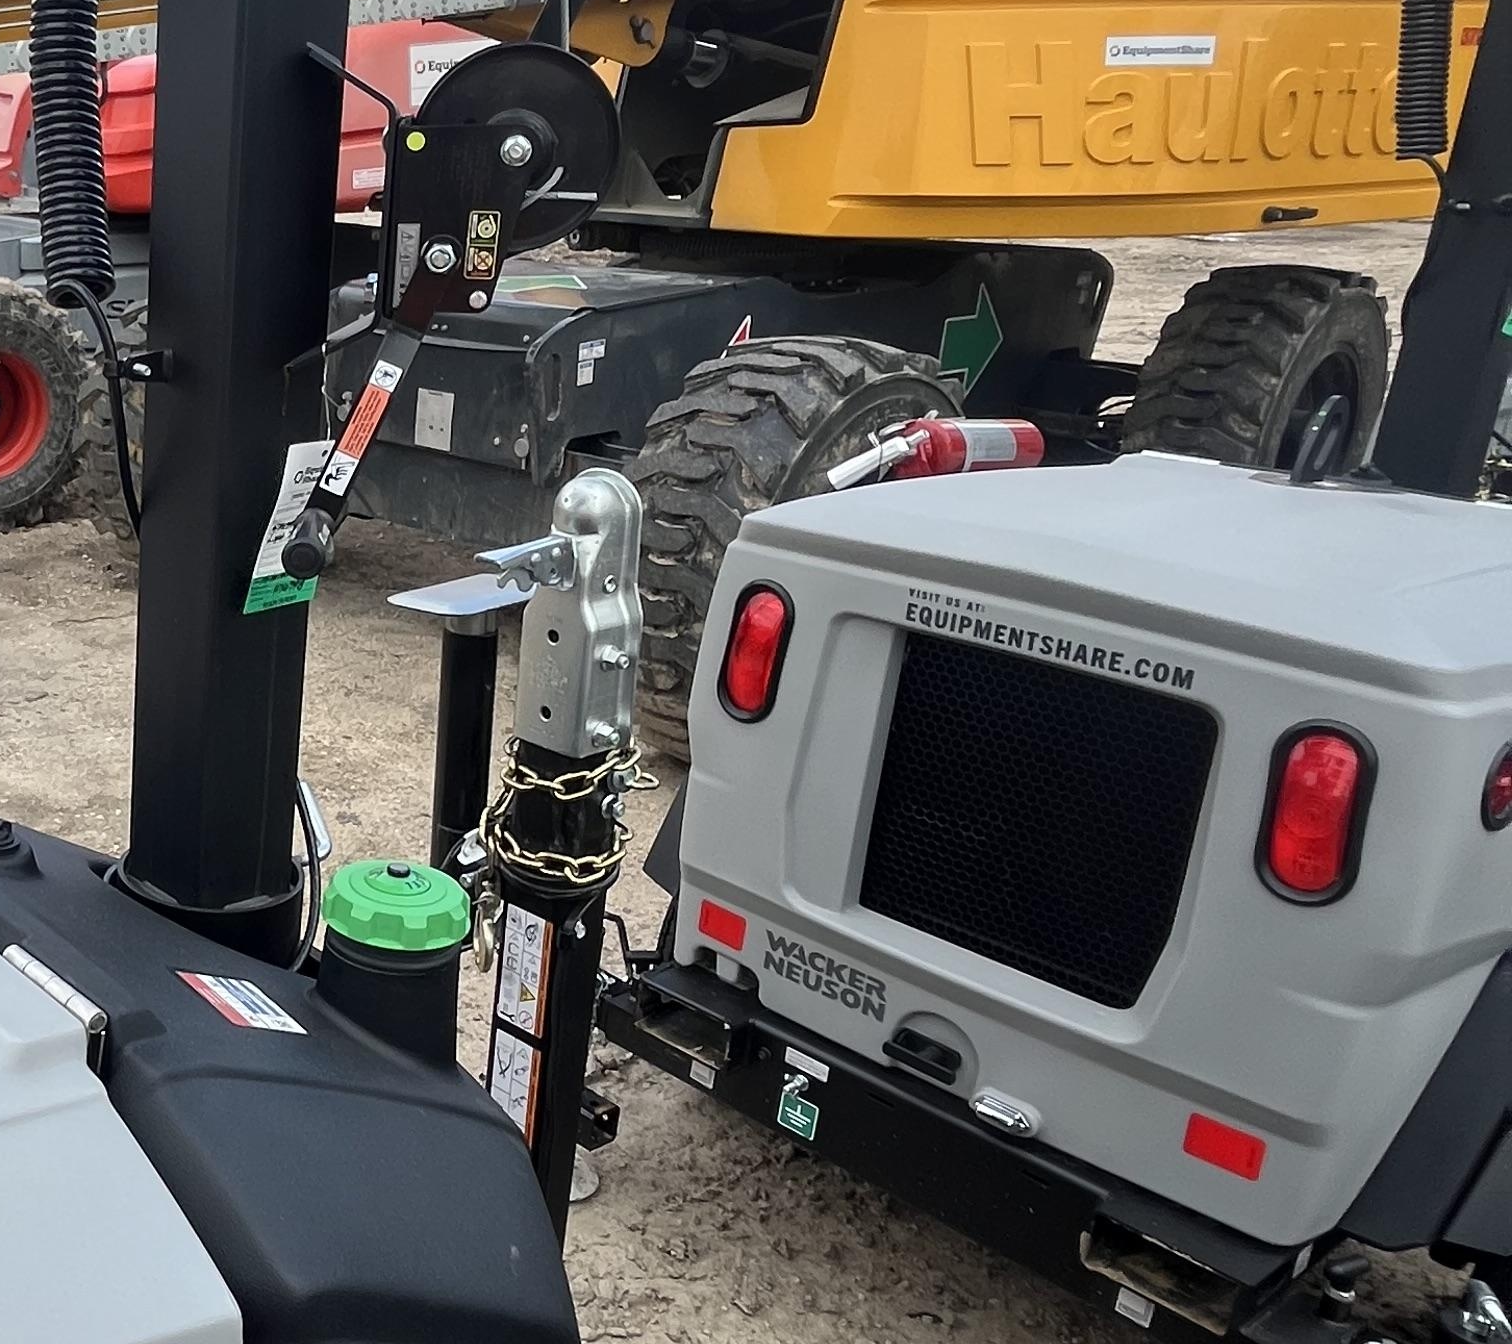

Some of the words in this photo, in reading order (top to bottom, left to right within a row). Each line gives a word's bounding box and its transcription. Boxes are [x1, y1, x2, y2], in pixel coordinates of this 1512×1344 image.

[1122, 45, 1211, 56] EquipmentShare
[909, 588, 941, 604] VISIT
[946, 596, 961, 609] US
[905, 602, 1195, 691] EQUIPMENTSHARE.COM
[763, 950, 887, 1024] NEUSON
[766, 928, 888, 1004] WACKER
